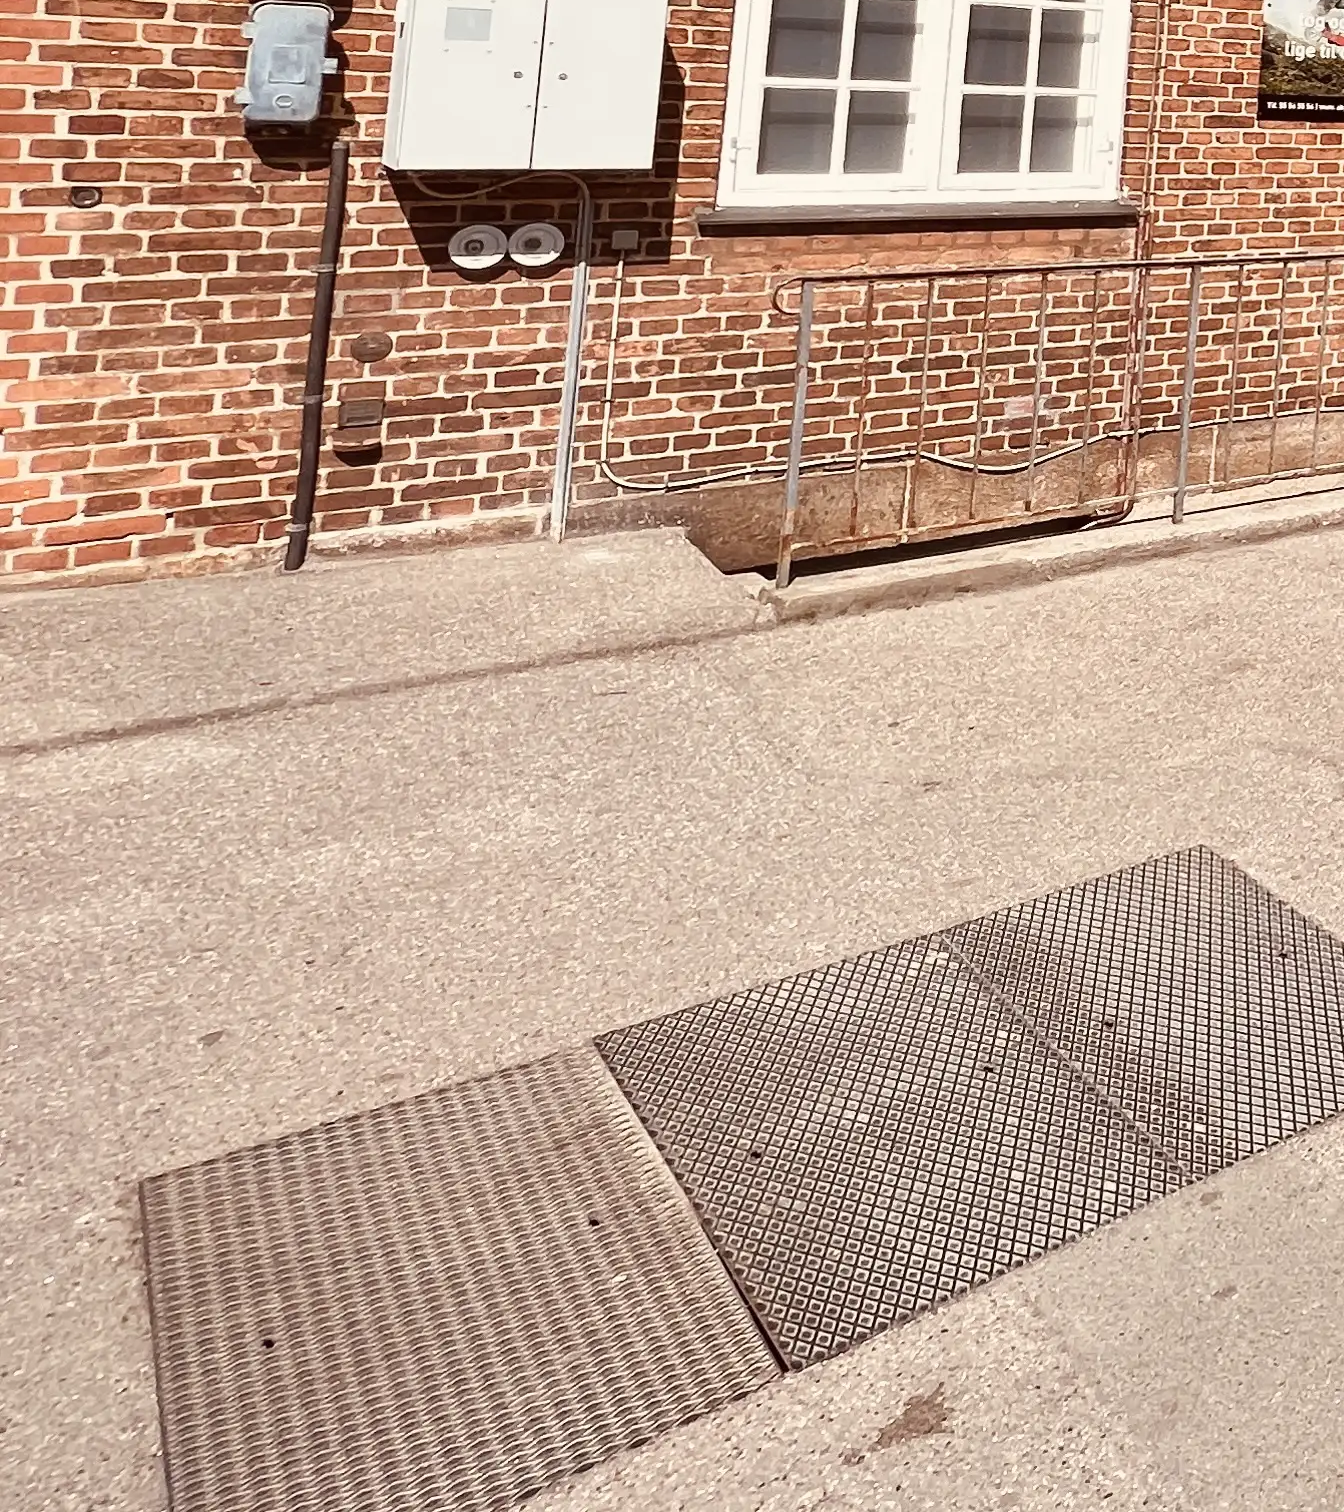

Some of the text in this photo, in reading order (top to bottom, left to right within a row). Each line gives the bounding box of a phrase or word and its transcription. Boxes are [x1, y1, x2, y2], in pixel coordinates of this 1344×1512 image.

[1300, 13, 1325, 31] tog
[1284, 41, 1316, 62] lige
[1319, 43, 1337, 59] til
